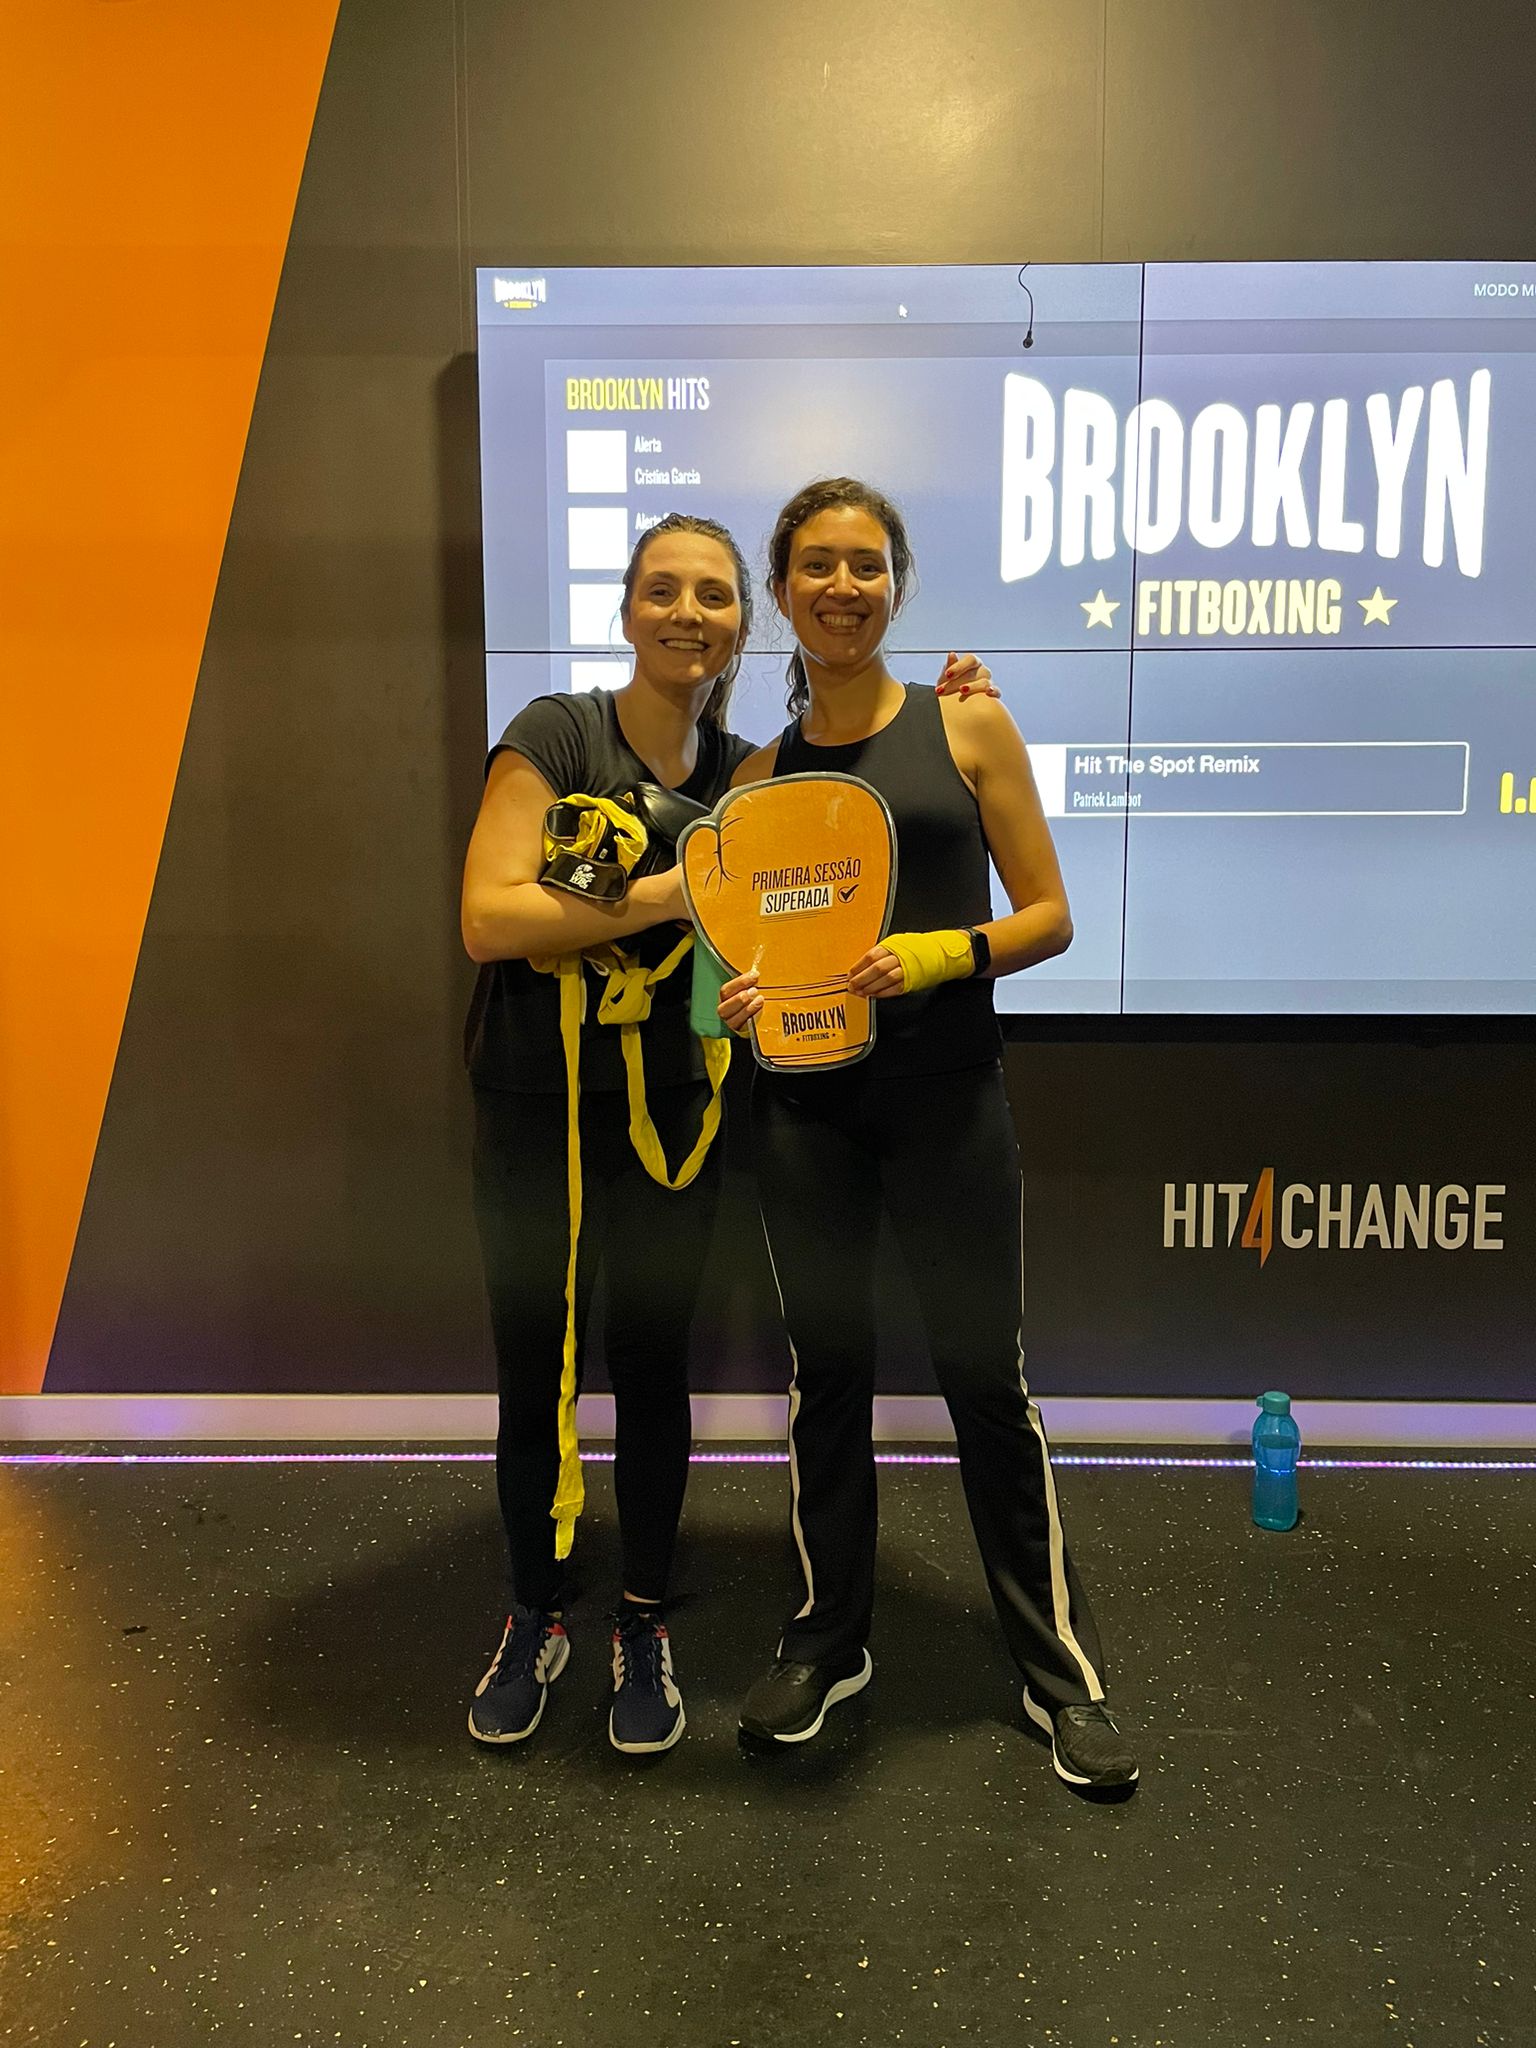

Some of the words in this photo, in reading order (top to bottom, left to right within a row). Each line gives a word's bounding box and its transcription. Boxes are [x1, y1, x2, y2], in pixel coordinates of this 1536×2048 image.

[1474, 283, 1519, 297] MODO
[1522, 283, 1536, 297] M
[566, 377, 664, 411] BROOKLYN
[667, 377, 710, 411] HITS
[634, 434, 662, 453] Alerta
[634, 467, 670, 485] Cristina
[1000, 368, 1491, 583] BROOKLYN
[1138, 579, 1342, 636] FITBOXING
[1074, 755, 1102, 774] Hit
[1106, 755, 1145, 774] The
[1149, 755, 1195, 777] Spot
[1200, 755, 1260, 773] Remix
[1073, 792, 1105, 808] Patrick
[752, 865, 810, 891] PRIMEIRA
[814, 857, 861, 883] SESSÃO
[765, 887, 829, 913] SUPERADA
[781, 1004, 847, 1038] BROOKLYN
